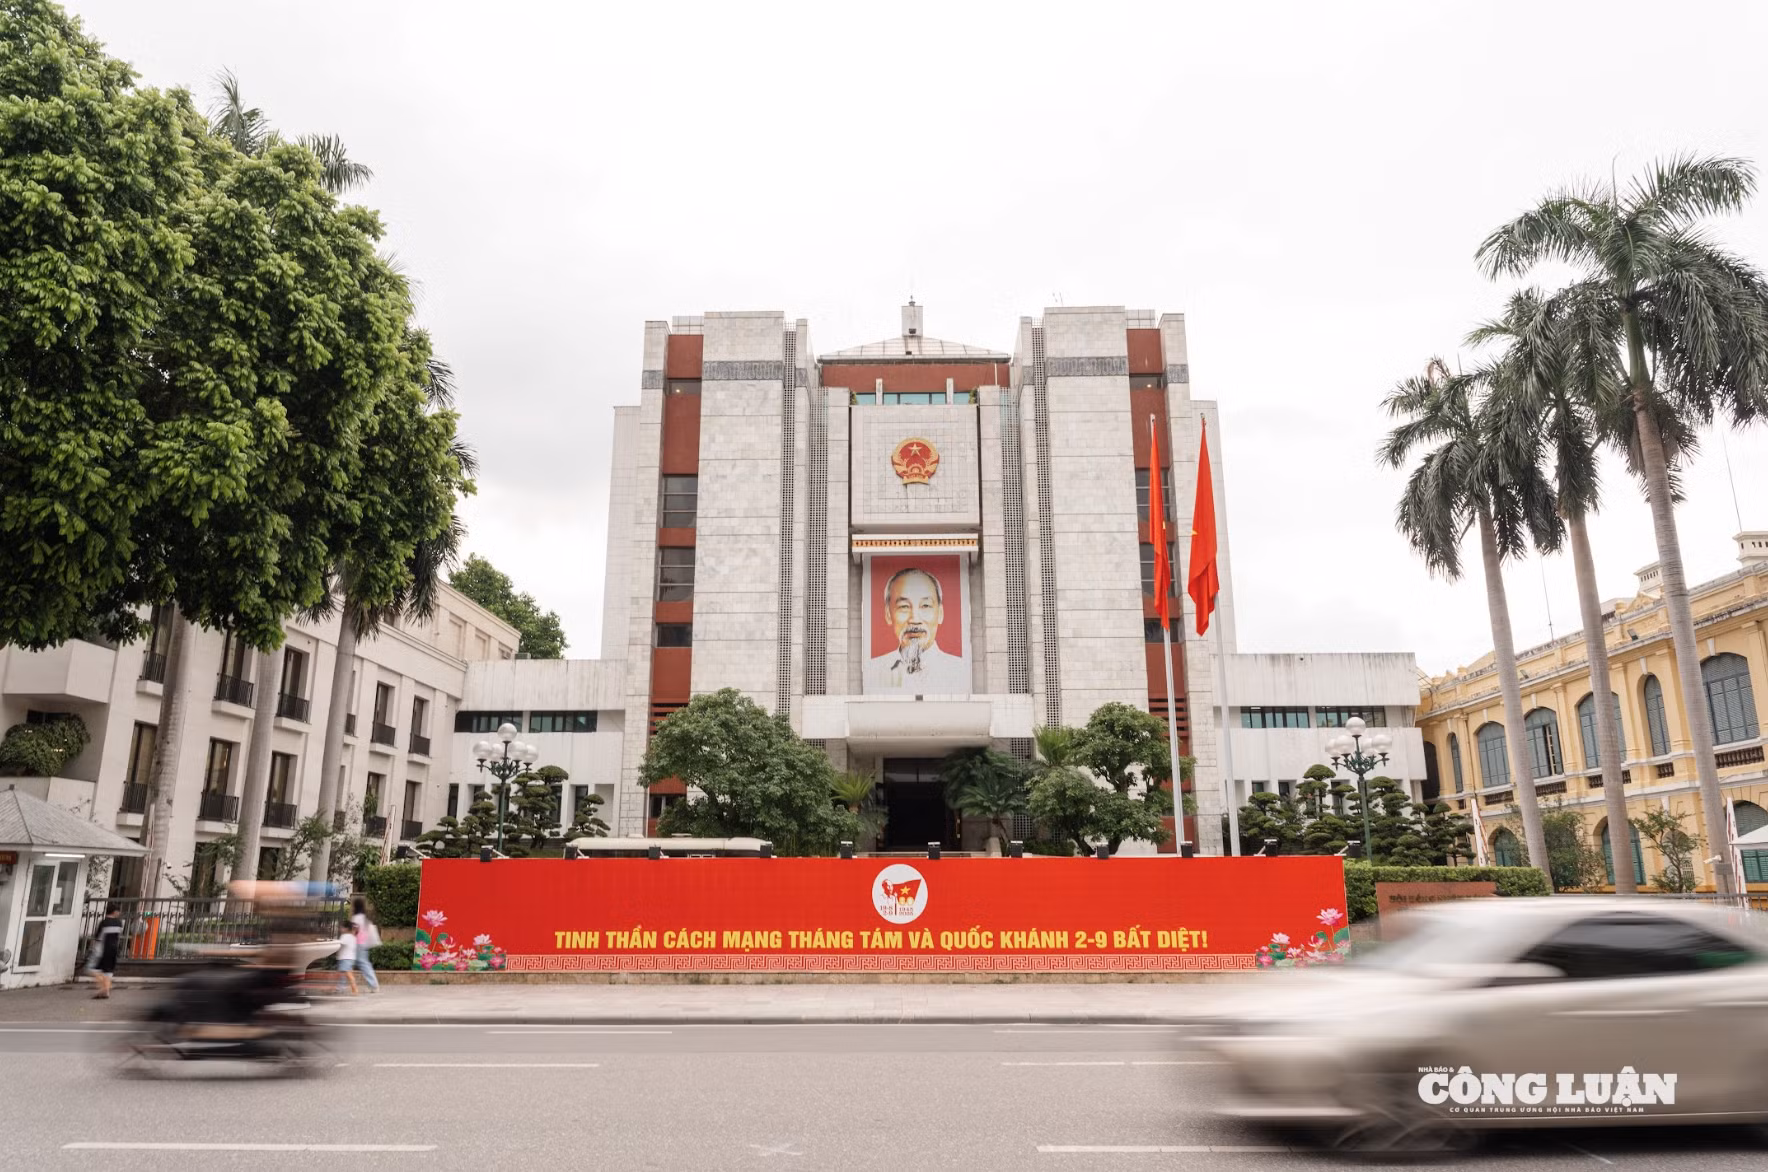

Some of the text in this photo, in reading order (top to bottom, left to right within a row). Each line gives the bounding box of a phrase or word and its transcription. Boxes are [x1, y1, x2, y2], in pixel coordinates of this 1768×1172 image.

[554, 924, 1209, 952] TINH THẦN CÁCH MẠNG THÁNG TÁM VÀ QUỐC KHÁNH 2-9 BẤT DIỆT!
